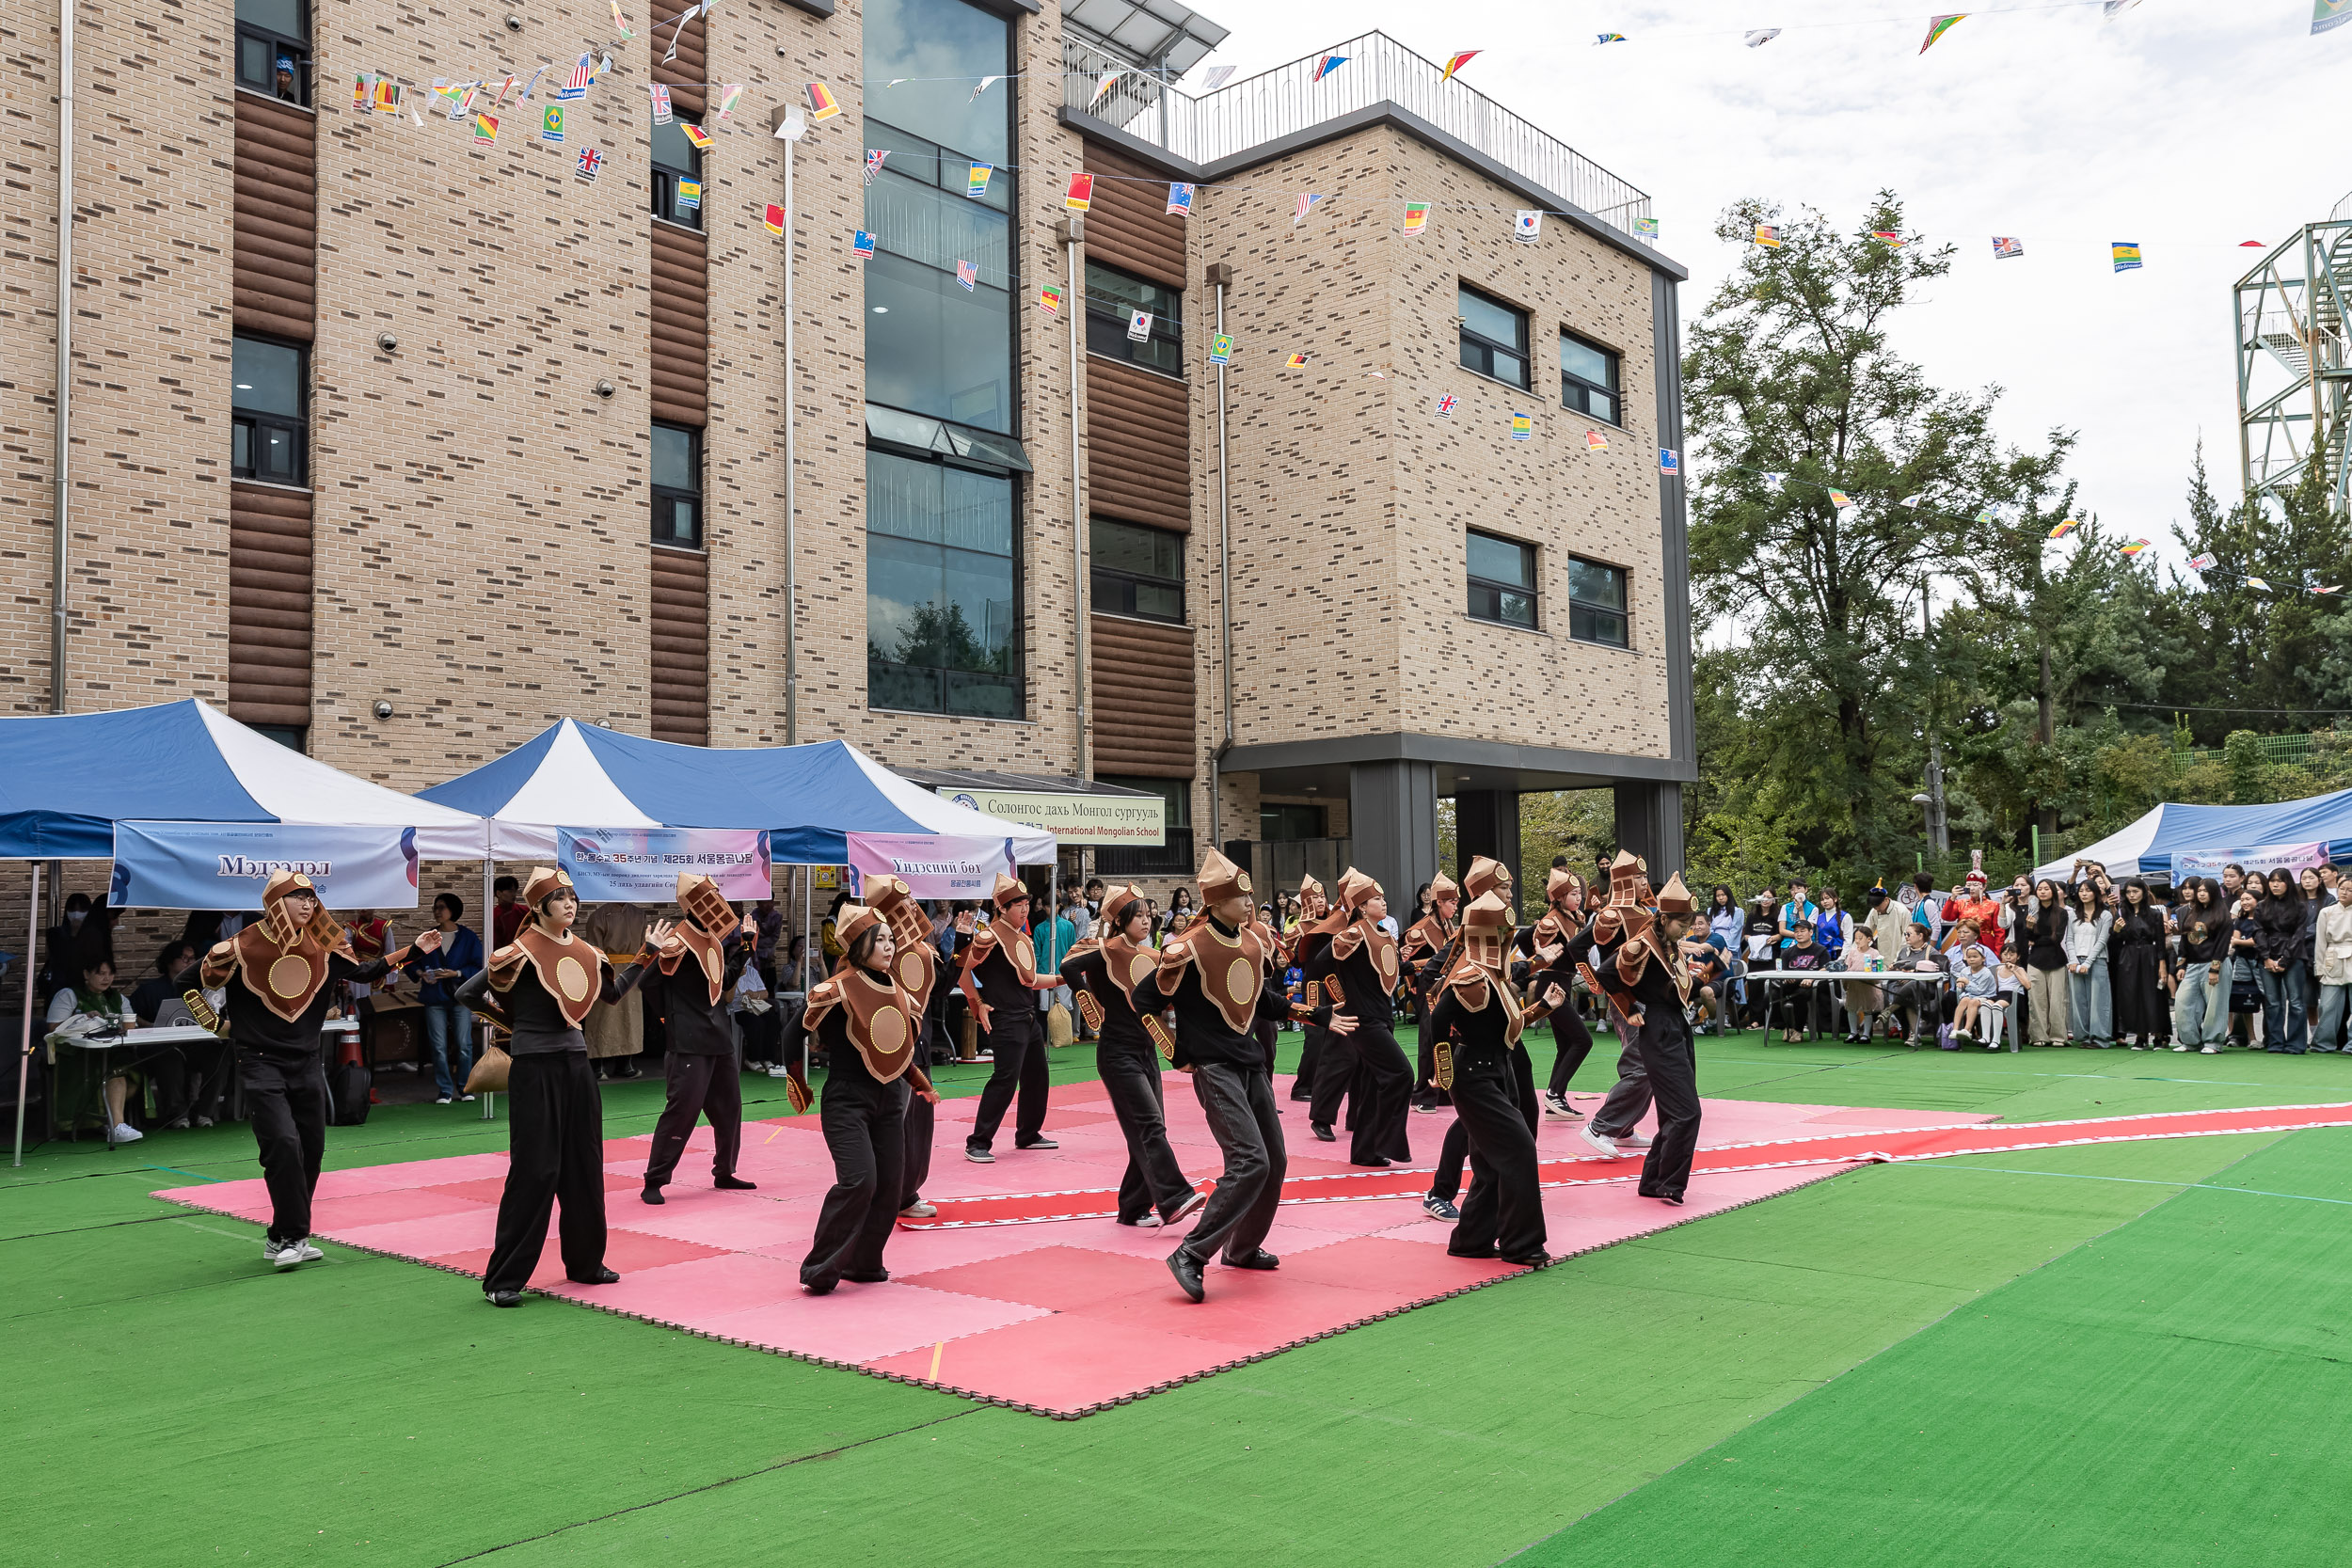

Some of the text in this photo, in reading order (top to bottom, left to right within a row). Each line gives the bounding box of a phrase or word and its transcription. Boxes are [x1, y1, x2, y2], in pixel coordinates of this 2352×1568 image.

[1067, 199, 1088, 208] Welcome
[1516, 233, 1538, 242] Welcome
[2115, 262, 2141, 272] Welcome
[988, 800, 1041, 815] Солонгос
[1045, 805, 1069, 816] дахь
[1073, 803, 1112, 817] Монгол
[1115, 808, 1159, 821] сургууль
[1047, 825, 1095, 835] International
[1097, 826, 1135, 838] Mongolian
[1136, 827, 1159, 836] School
[644, 854, 658, 863] 기념
[663, 854, 694, 864] 제25회
[697, 853, 754, 864] 서울몽골나담
[218, 856, 331, 879] Мэдээлэл
[893, 858, 982, 875] Үндэсний бөх
